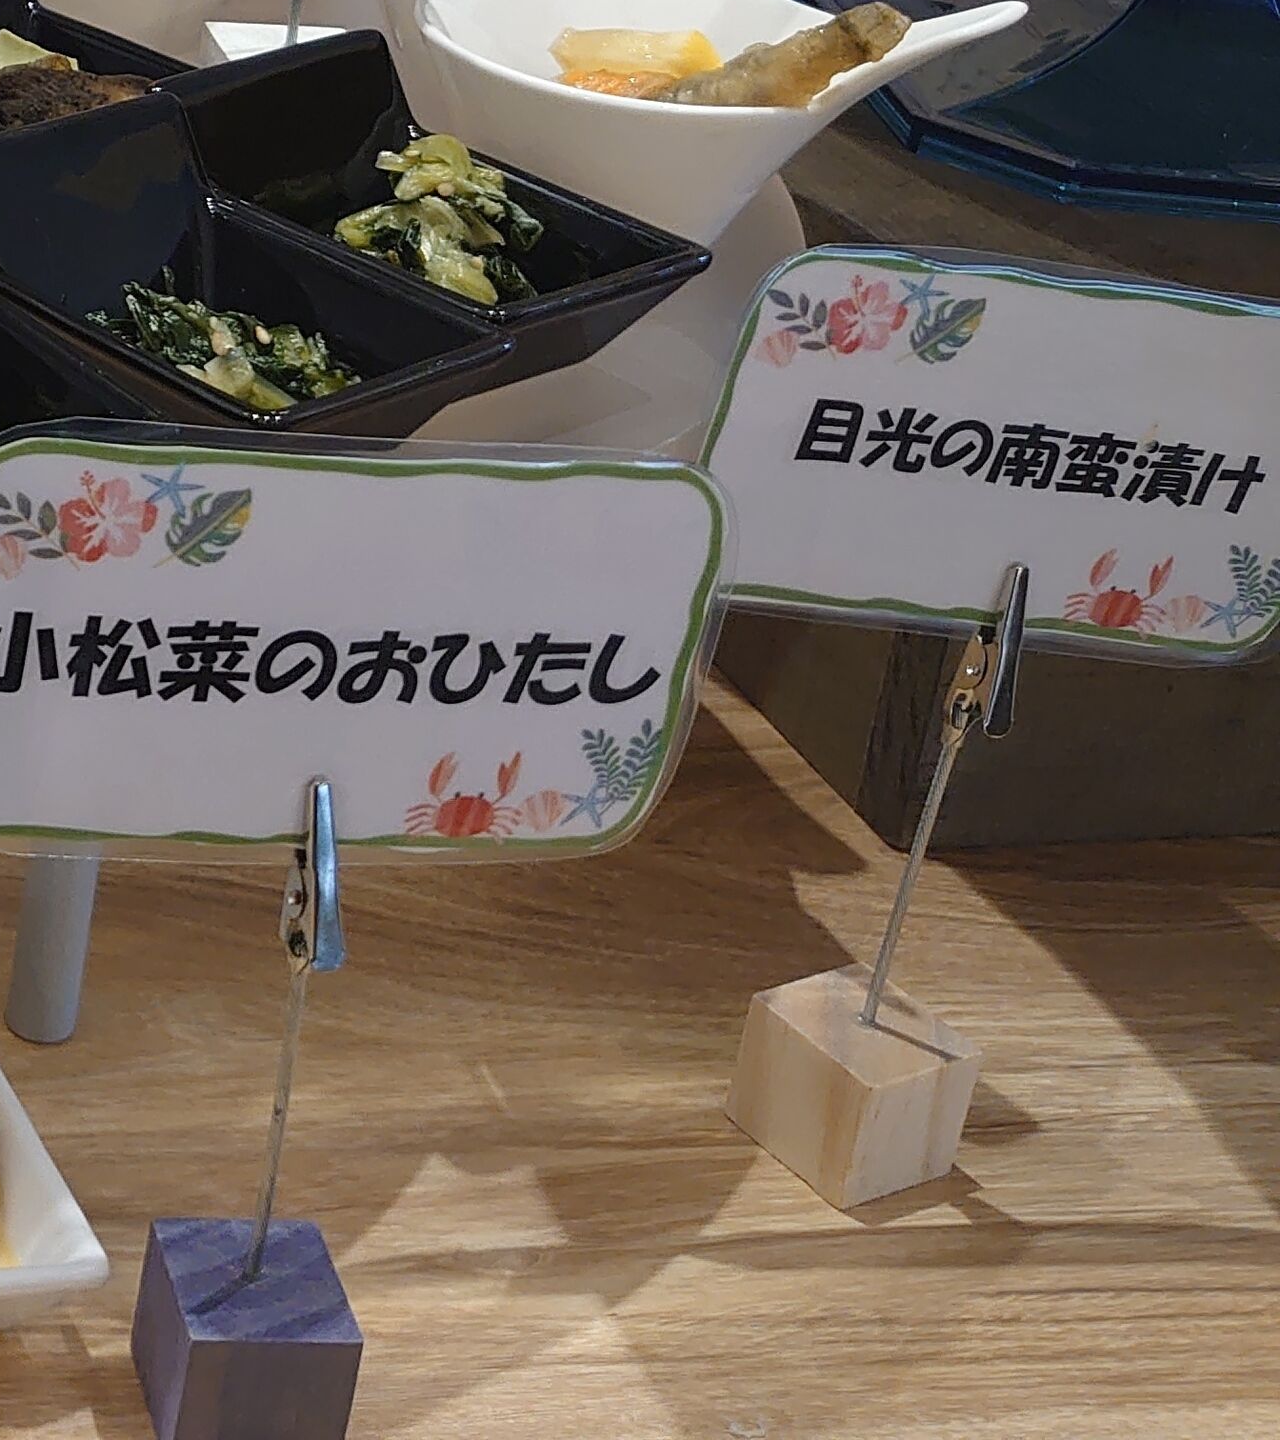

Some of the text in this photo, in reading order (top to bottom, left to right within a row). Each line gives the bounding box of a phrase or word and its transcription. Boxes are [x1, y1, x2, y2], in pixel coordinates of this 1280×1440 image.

[793, 397, 1268, 515] 目光の南蛮漬け
